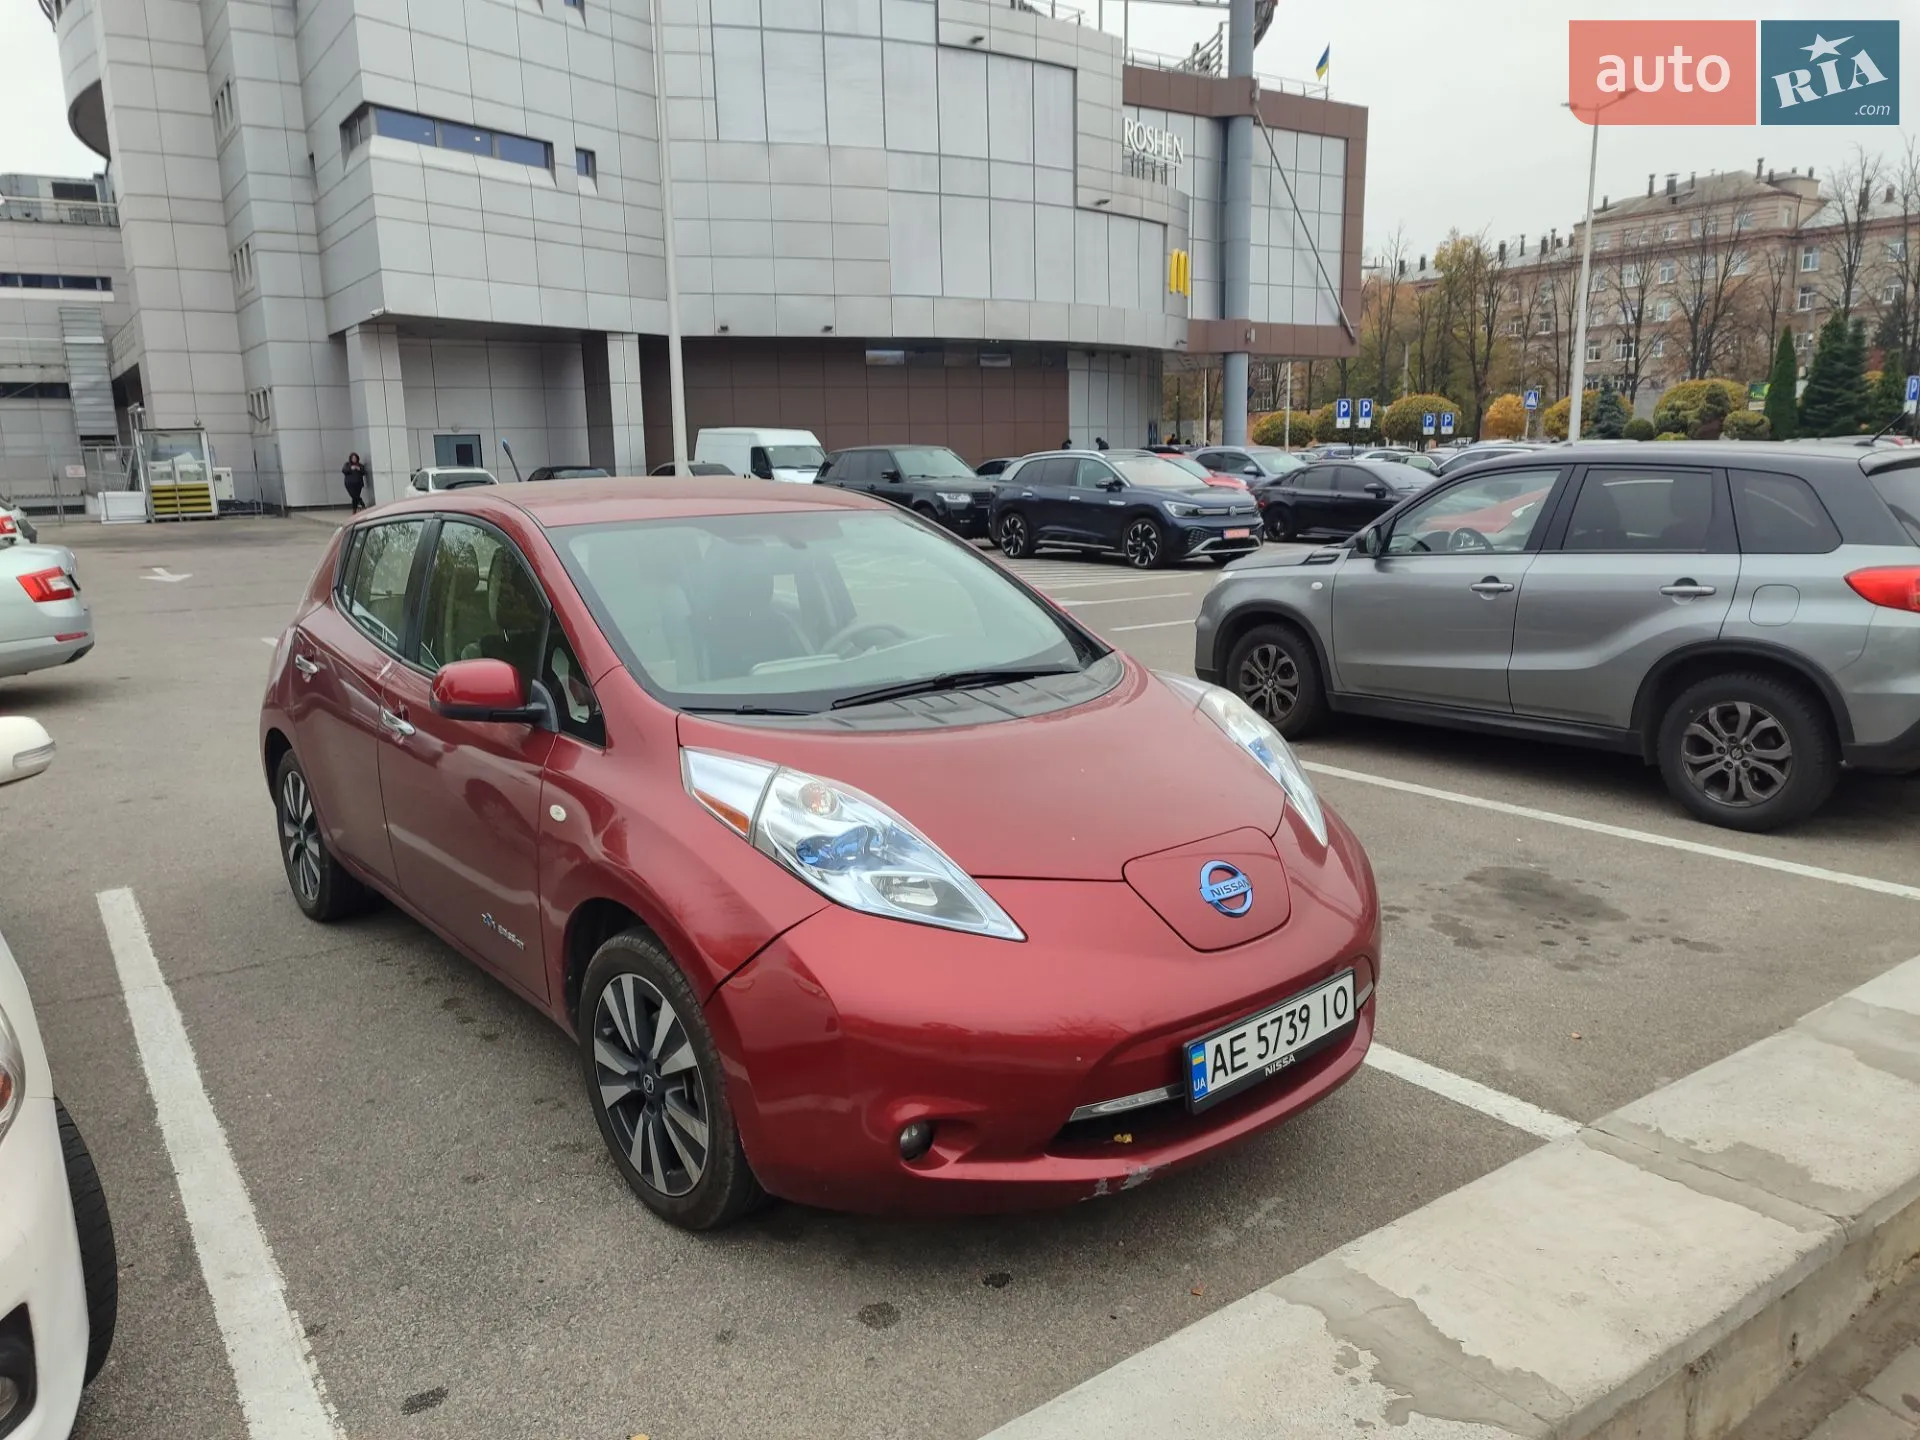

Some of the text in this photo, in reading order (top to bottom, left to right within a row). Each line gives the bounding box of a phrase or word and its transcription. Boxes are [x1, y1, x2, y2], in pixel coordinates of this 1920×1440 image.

[1125, 117, 1184, 163] ROSHEN
[1340, 401, 1348, 417] P
[1362, 401, 1370, 417] P
[1426, 415, 1433, 426] P
[1444, 414, 1451, 426] P
[1210, 879, 1250, 898] NISSAN
[1211, 985, 1348, 1084] AE 5739 IO
[1193, 1079, 1206, 1092] UA
